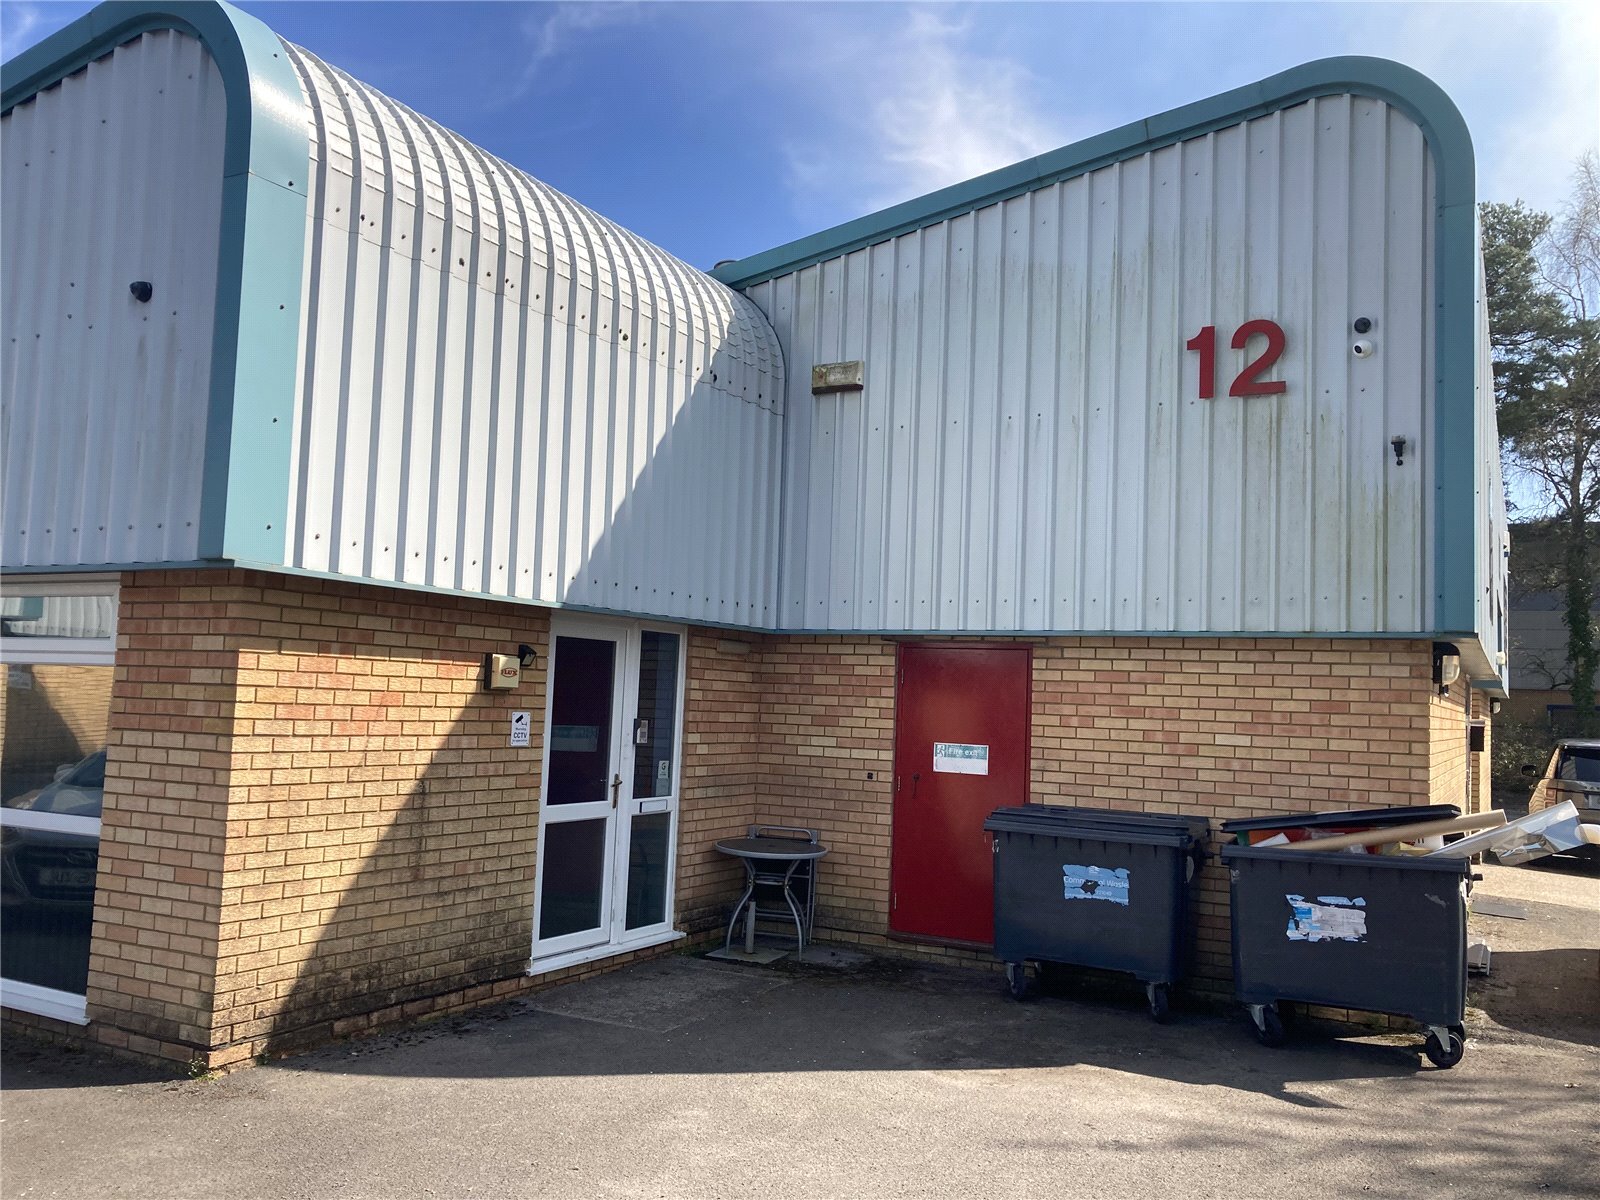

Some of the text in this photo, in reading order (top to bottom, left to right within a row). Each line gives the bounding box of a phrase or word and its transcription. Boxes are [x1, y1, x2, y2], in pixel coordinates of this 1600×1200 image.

[1187, 319, 1287, 399] 12
[1063, 876, 1129, 888] Commal Waste
